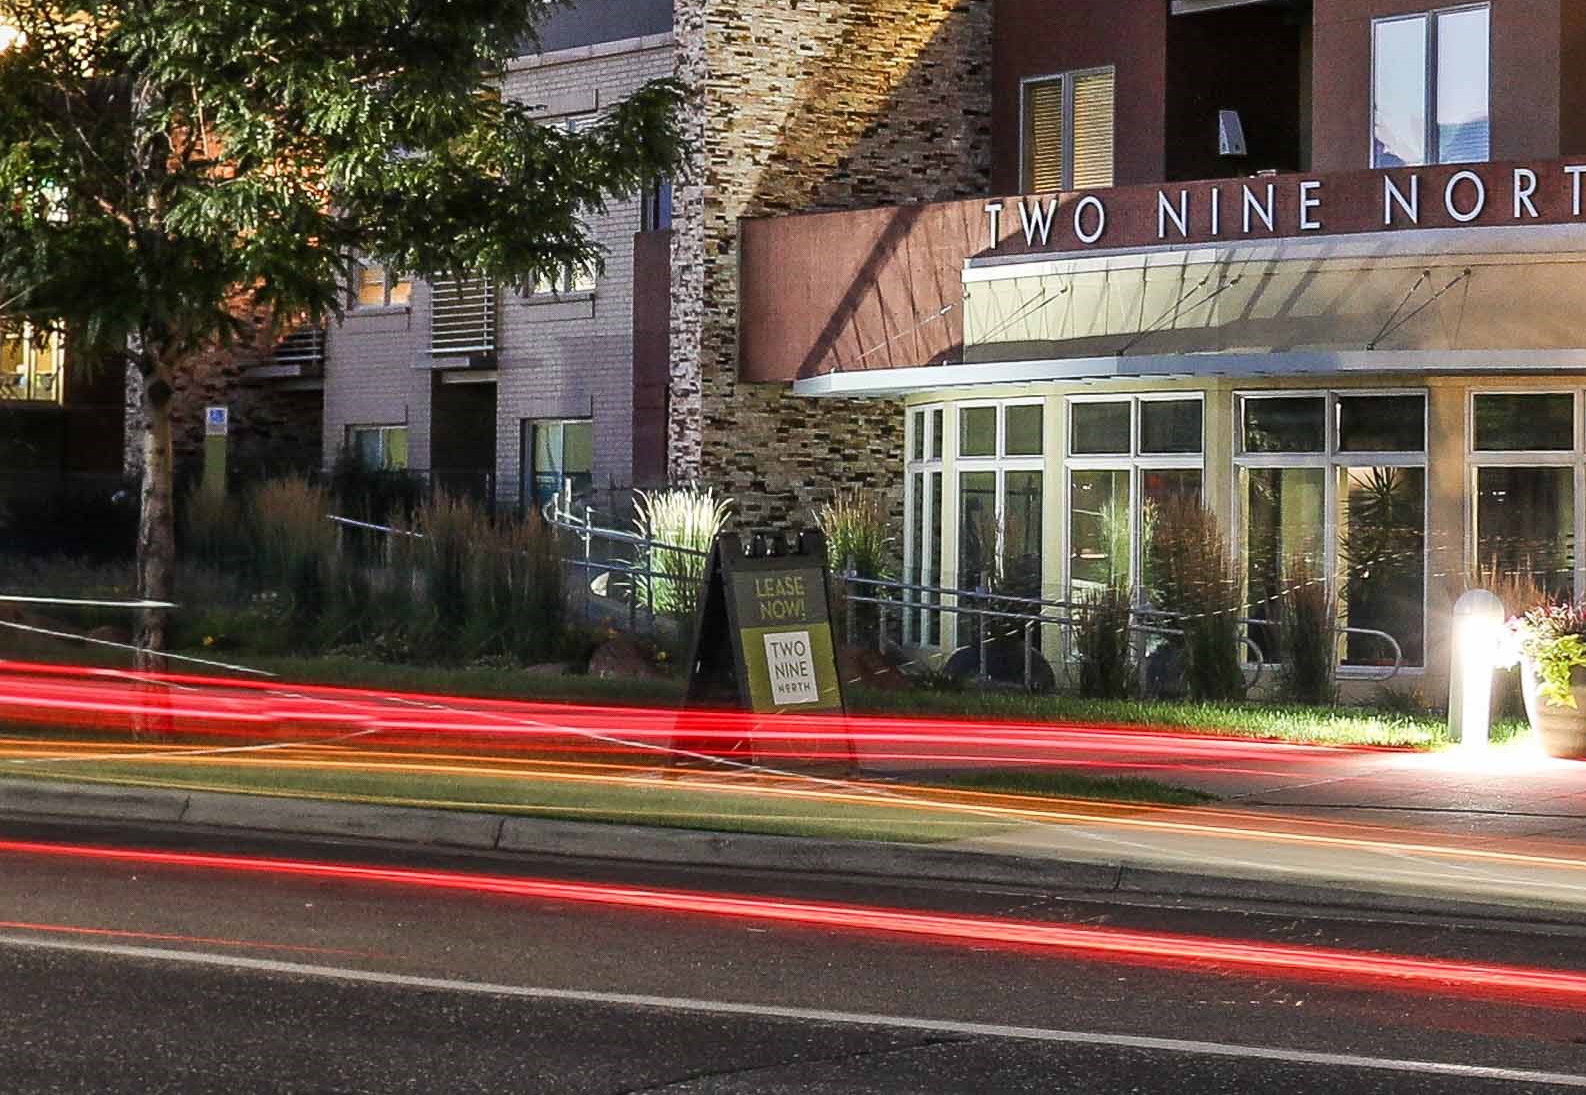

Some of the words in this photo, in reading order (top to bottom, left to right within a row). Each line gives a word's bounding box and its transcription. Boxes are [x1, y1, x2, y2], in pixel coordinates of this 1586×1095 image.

[984, 195, 1106, 250] TWO
[1157, 181, 1321, 239] NINE
[755, 576, 805, 598] LEASE
[760, 600, 806, 620] NOW!
[770, 640, 806, 658] TWO
[774, 661, 808, 679] NINE
[778, 682, 811, 694] NORTH
